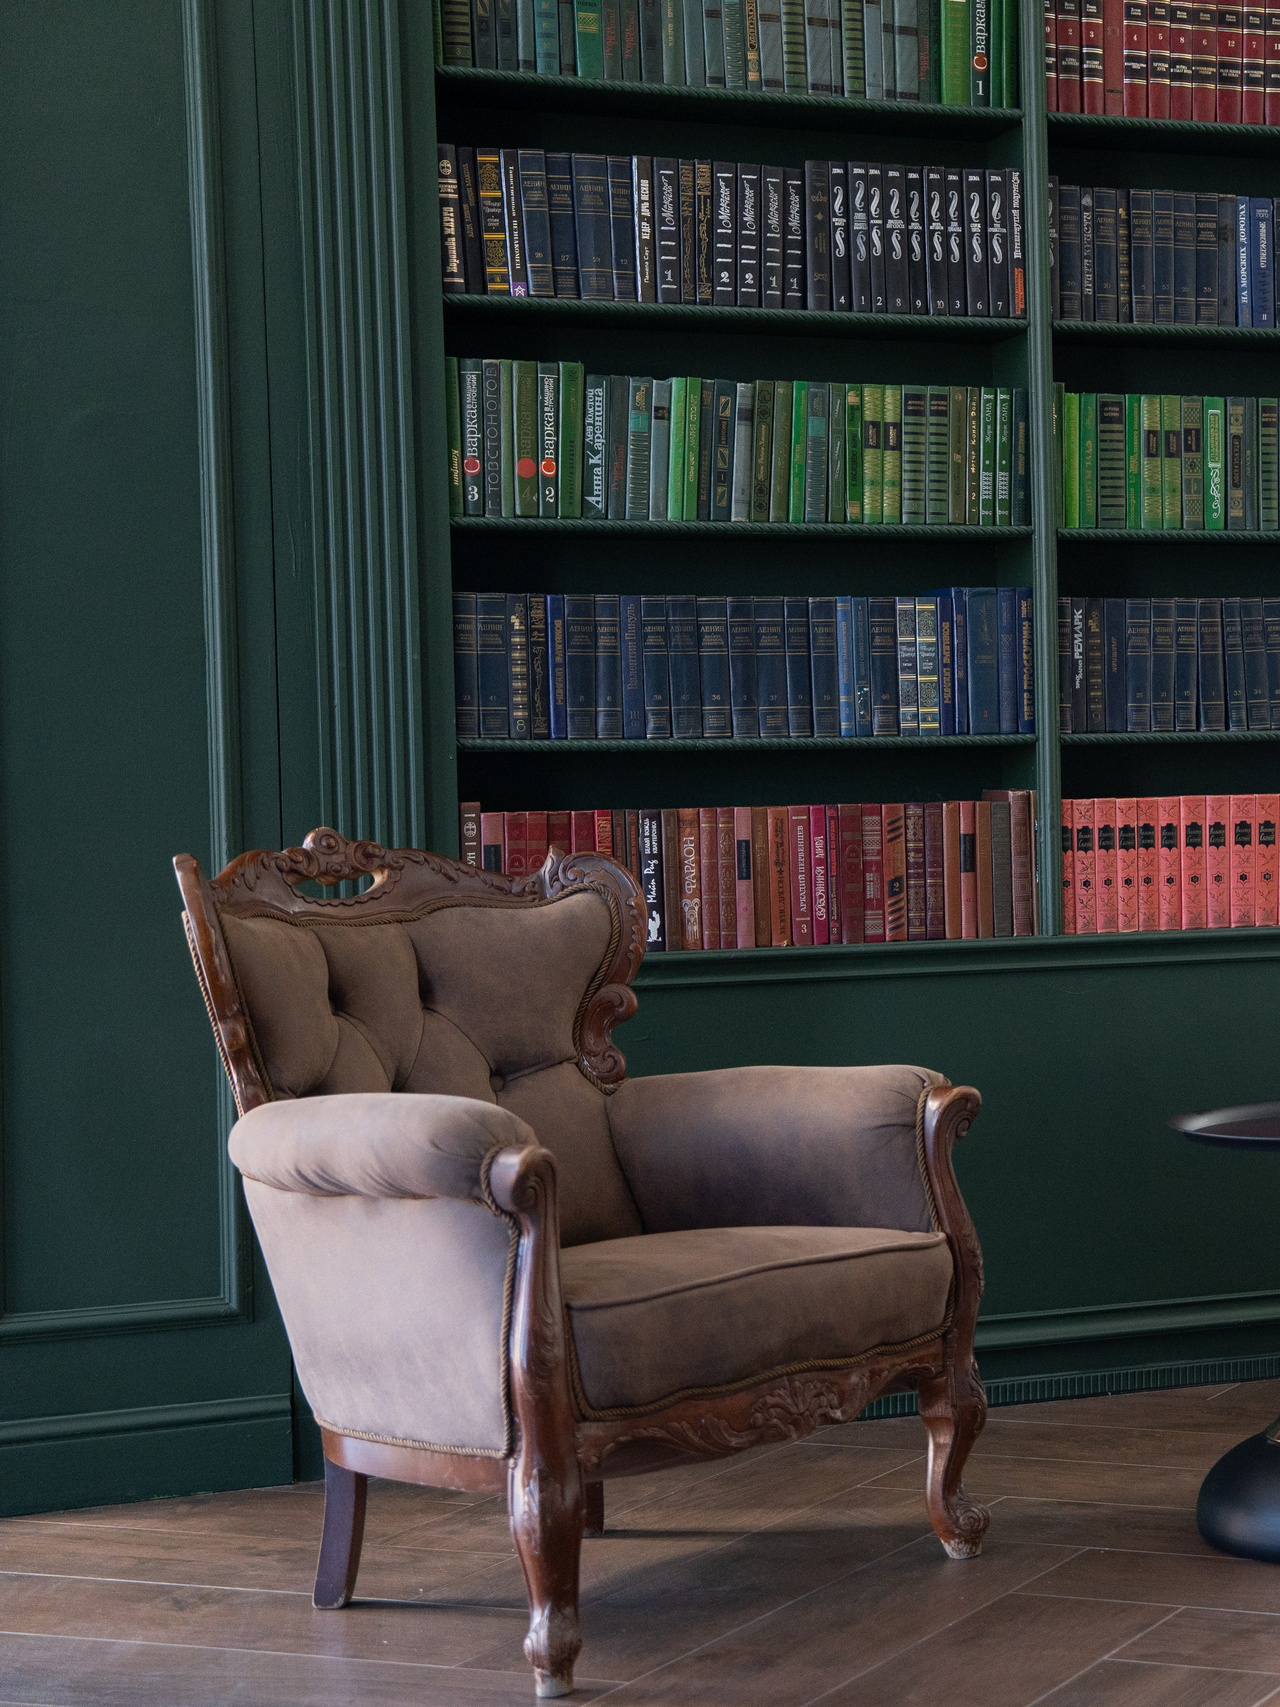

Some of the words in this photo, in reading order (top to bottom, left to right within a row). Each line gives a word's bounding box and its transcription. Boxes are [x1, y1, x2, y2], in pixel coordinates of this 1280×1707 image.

[974, 6, 988, 70] Сварка
[976, 80, 984, 96] 1
[640, 179, 650, 201] ПЕСКОВ
[641, 202, 650, 216] ДОЧЬ
[642, 222, 650, 239] ХЕДЕР
[665, 269, 672, 282] 1
[720, 271, 730, 283] 2
[744, 272, 754, 284] 2
[770, 276, 777, 287] 1
[790, 277, 797, 289] 1
[839, 296, 845, 304] 4
[861, 296, 865, 304] 1
[877, 297, 882, 306] 2
[896, 298, 901, 307] 8
[916, 299, 922, 308] 9
[937, 300, 944, 309] 10
[955, 300, 960, 309] 3
[1242, 291, 1248, 303] НА
[977, 301, 982, 310] 6
[998, 302, 1003, 310] 7
[585, 388, 594, 424] Толстой
[985, 402, 993, 421] САНД
[486, 367, 500, 493] ТОВСТОНОГОВ
[586, 388, 605, 465] Каренина
[464, 409, 481, 474] Сварка
[585, 426, 594, 444] Лев
[542, 412, 558, 475] Сварка
[451, 449, 459, 485] Катрин
[468, 485, 478, 501] 3
[546, 486, 554, 502] 2
[584, 467, 602, 510] Анна
[971, 492, 976, 500] 2
[625, 604, 637, 640] Пикуль
[554, 619, 562, 662] БУЛГАКОВ
[1074, 608, 1083, 659] РЕМАРК
[1022, 621, 1033, 690] ПРОСКУРИН
[627, 642, 637, 690] Валентин
[556, 667, 564, 706] МИХАИЛ
[1024, 694, 1033, 721] ПЕТР
[516, 720, 526, 732] 8
[814, 835, 824, 858] МИРА
[644, 859, 658, 874] Рид
[684, 836, 696, 894] ФАРАОН
[647, 878, 656, 902] Майн
[815, 866, 826, 920] СКАЗОЧНИКИ
[894, 882, 899, 891] 2
[801, 924, 808, 933] 3
